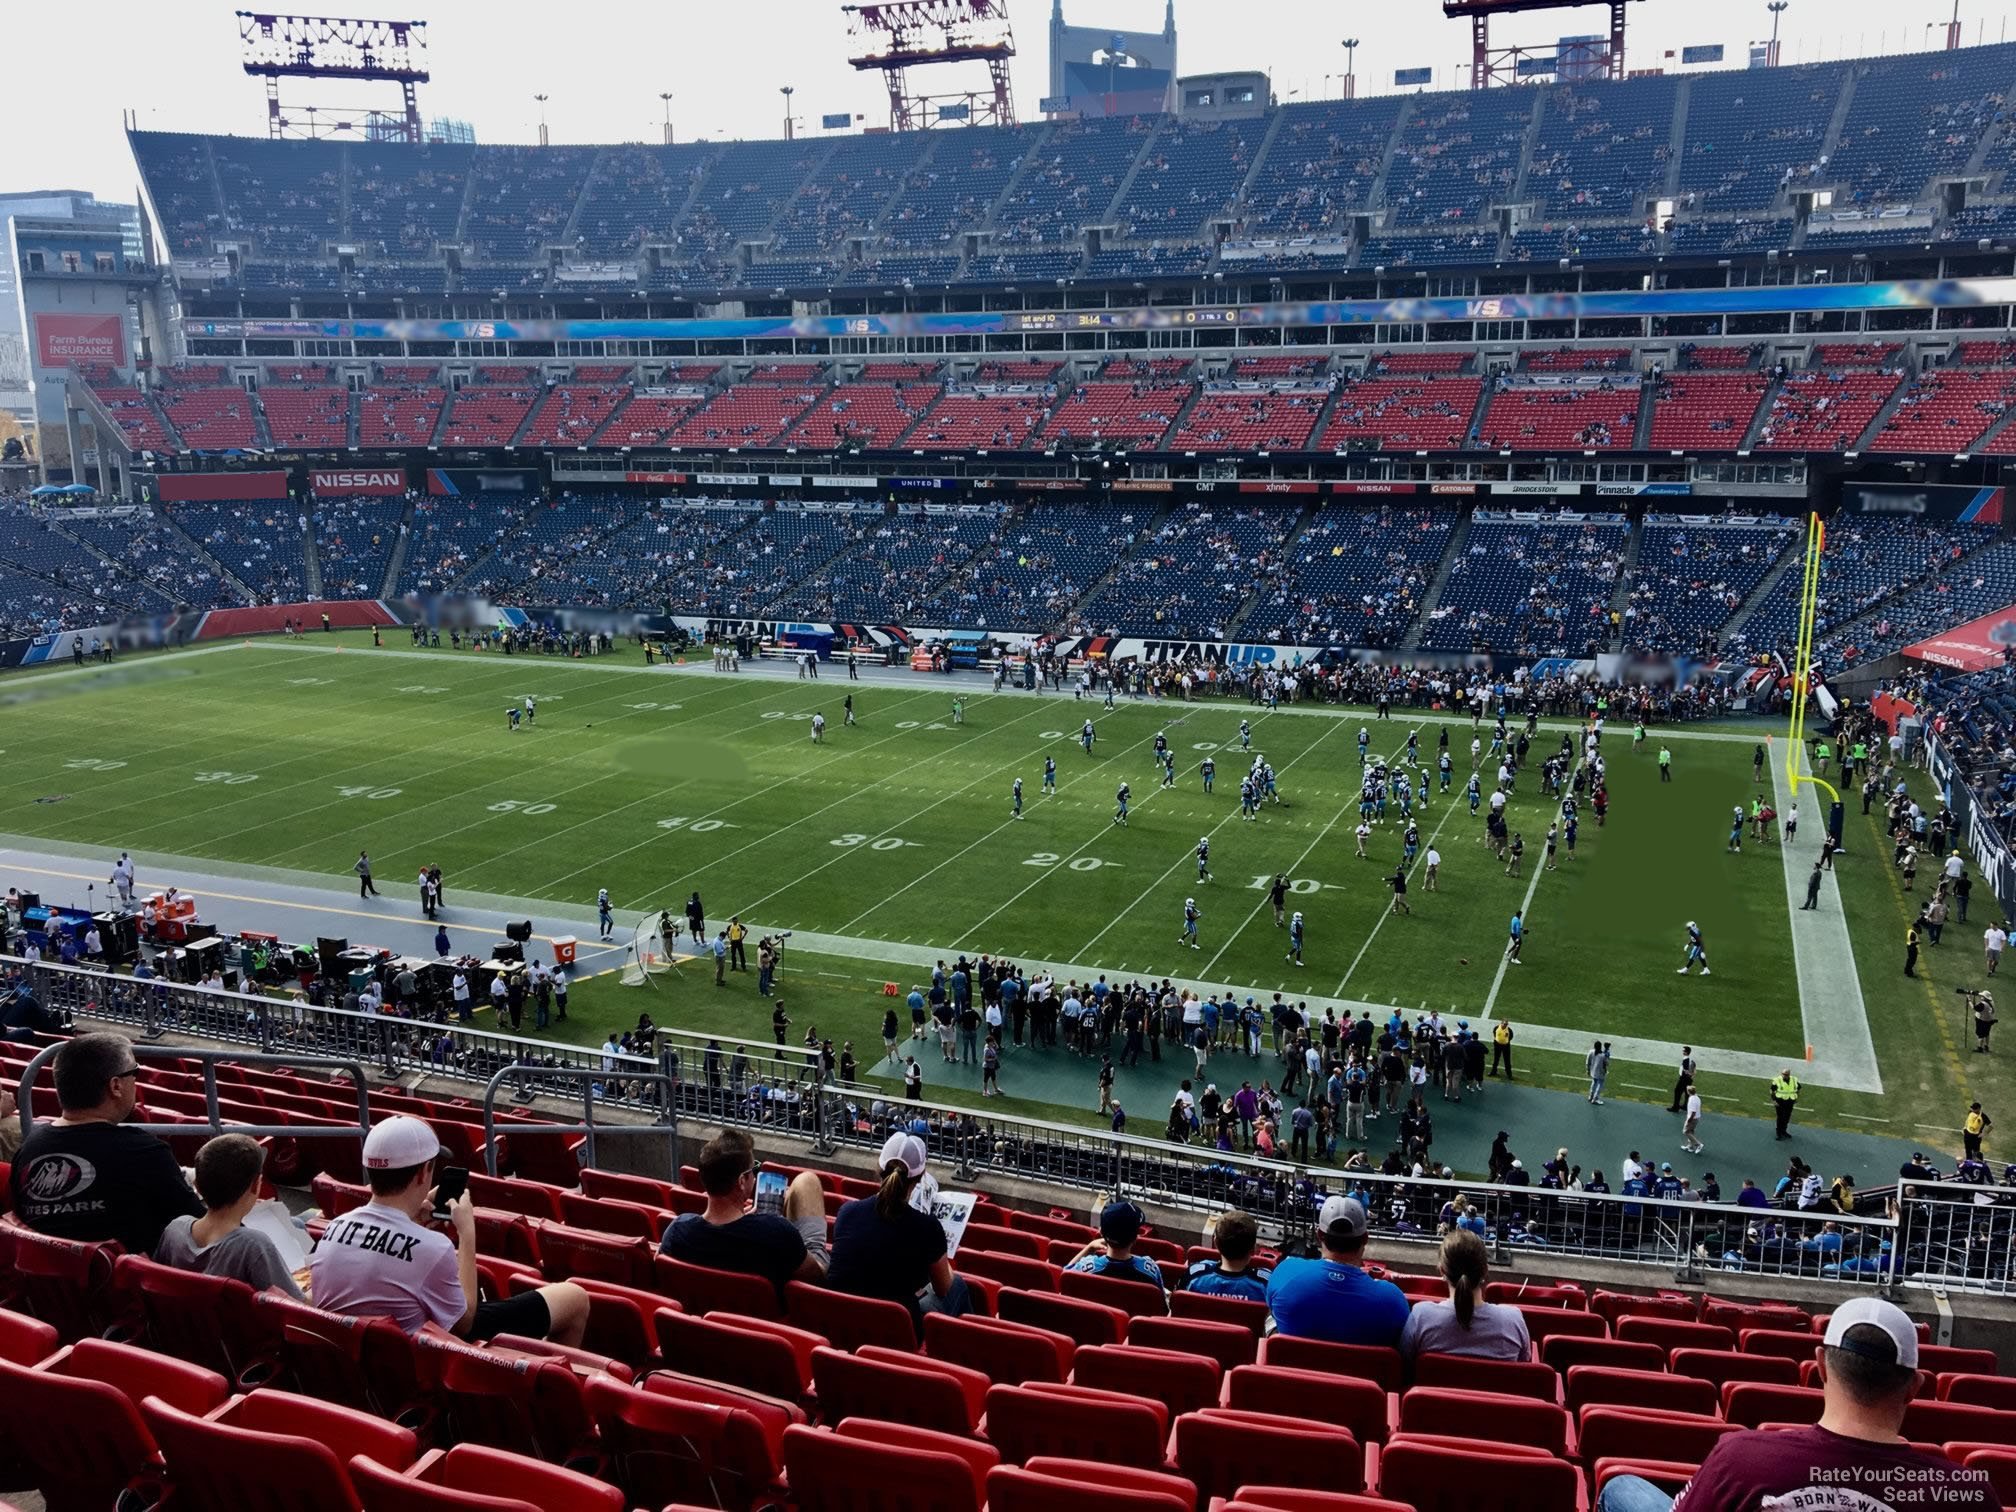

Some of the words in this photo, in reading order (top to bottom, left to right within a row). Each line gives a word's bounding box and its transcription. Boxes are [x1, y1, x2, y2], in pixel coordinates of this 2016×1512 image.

[50, 336, 75, 345] Farm
[78, 336, 113, 345] Bureau
[50, 346, 114, 355] INSURANCE
[44, 377, 65, 385] Auto
[316, 473, 399, 487] NISSAN
[974, 480, 994, 488] FedEx
[1196, 482, 1215, 492] CMT
[1266, 483, 1291, 493] xfinity
[1598, 485, 1634, 495] Pinnacle
[1143, 641, 1276, 666] TITANUP
[1922, 651, 1964, 668] NISSAN
[486, 800, 557, 815] 50
[656, 817, 724, 832] 40
[829, 834, 904, 851] 30
[1022, 852, 1102, 871] 20
[1245, 875, 1322, 894] 10
[562, 946, 572, 957] G
[886, 985, 896, 996] 20
[1083, 1018, 1094, 1027] 85
[53, 1200, 106, 1214] PARK
[1391, 1205, 1407, 1220] 57
[337, 1221, 363, 1245] IT
[360, 1226, 421, 1263] BACK
[1793, 1493, 1835, 1508] BORN
